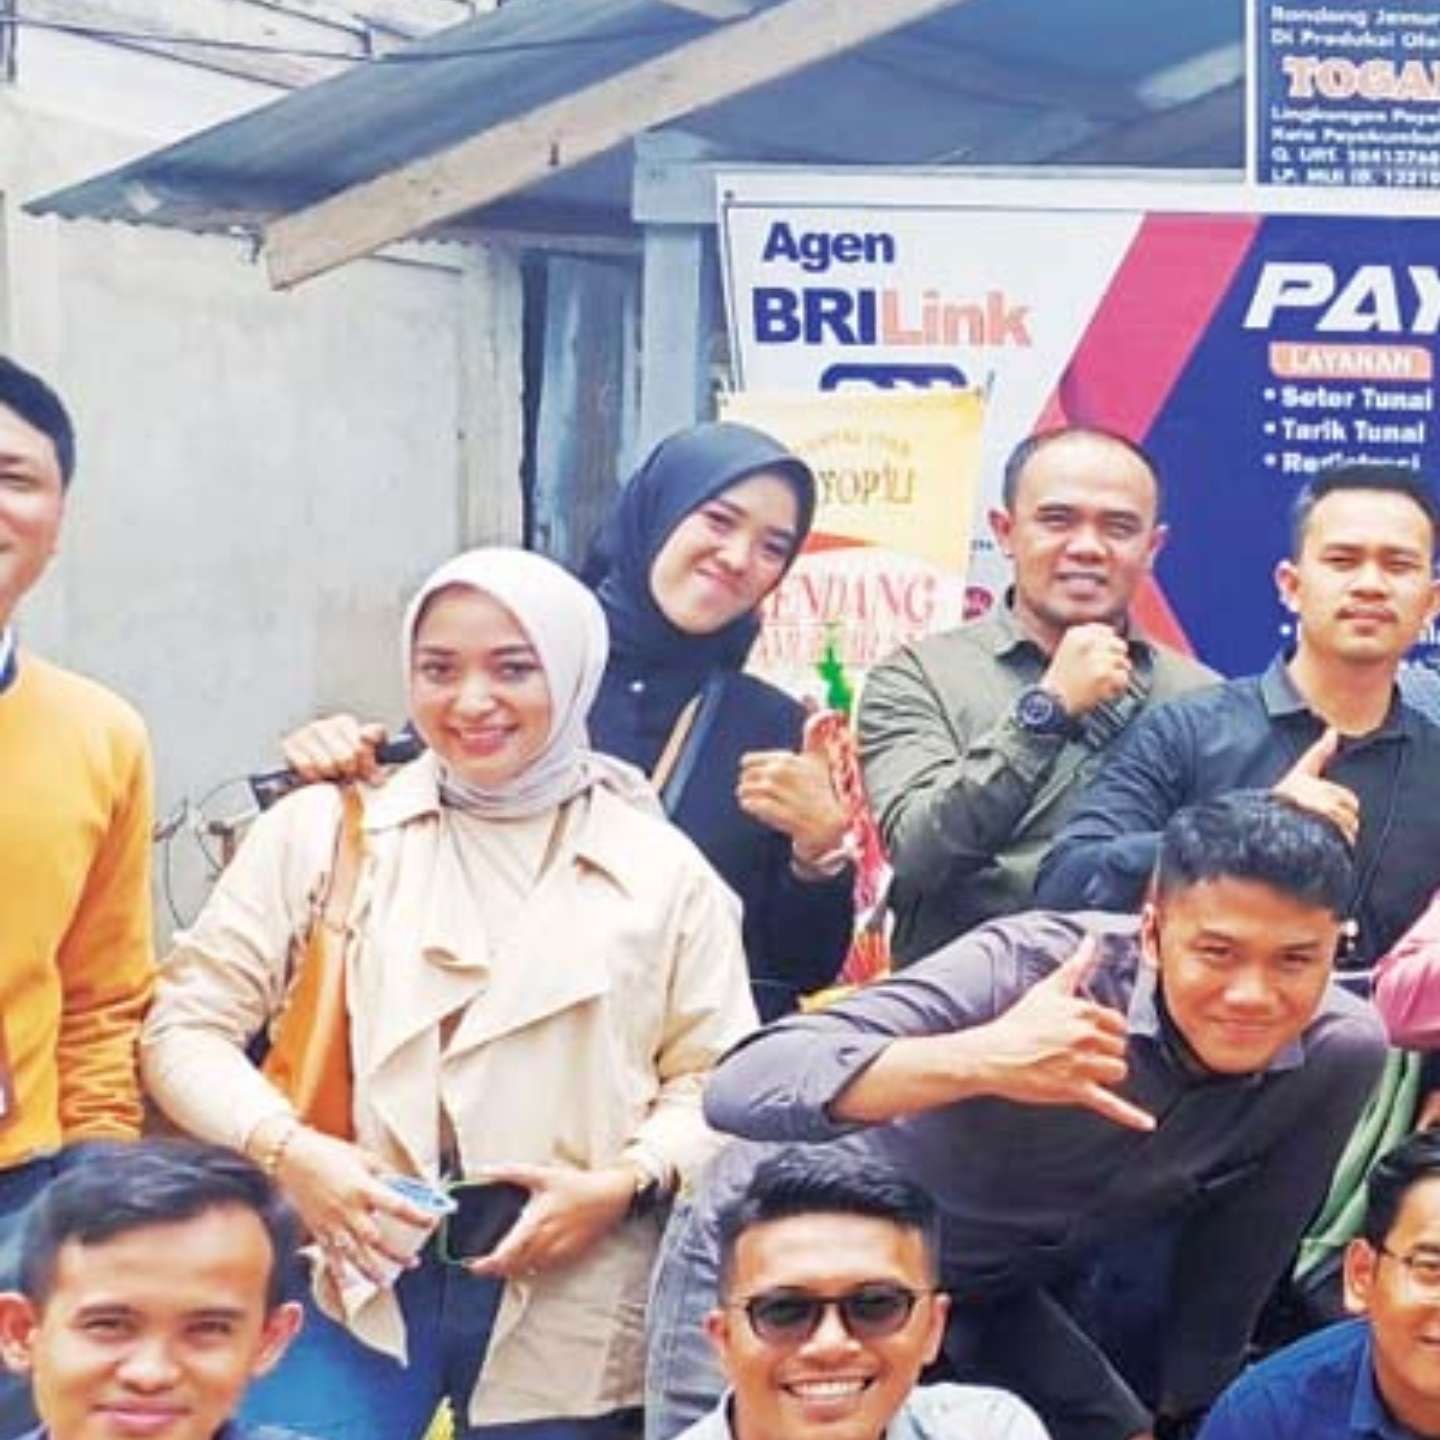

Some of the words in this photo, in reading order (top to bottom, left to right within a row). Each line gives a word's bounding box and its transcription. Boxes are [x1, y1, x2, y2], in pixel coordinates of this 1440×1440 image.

[763, 222, 895, 271] Agen
[752, 287, 1033, 347] BRILink
[1293, 347, 1413, 373] LAYANAN
[1281, 386, 1354, 409] Setor
[1361, 387, 1433, 410] Tunai
[1281, 418, 1348, 442] Tarik
[1354, 420, 1425, 443] Tunai
